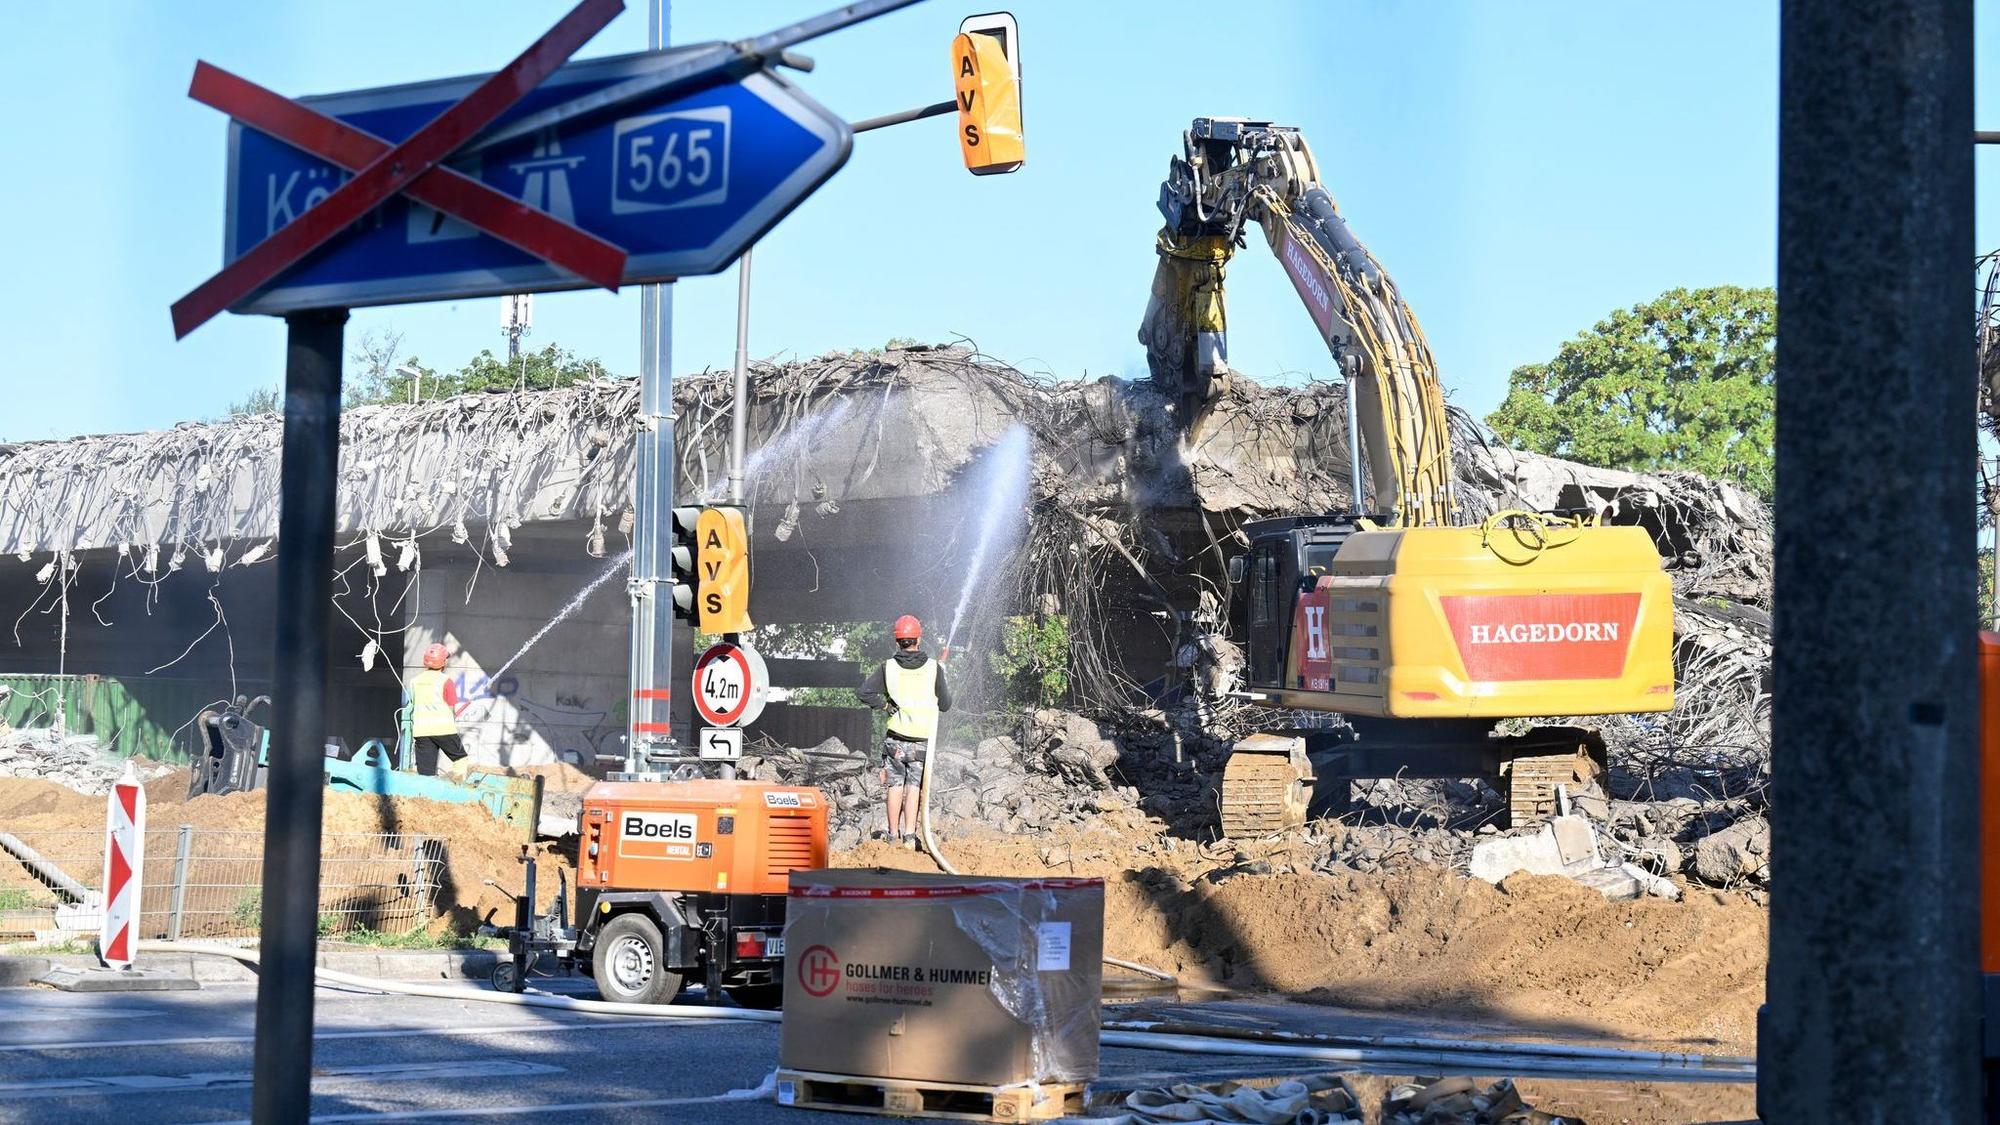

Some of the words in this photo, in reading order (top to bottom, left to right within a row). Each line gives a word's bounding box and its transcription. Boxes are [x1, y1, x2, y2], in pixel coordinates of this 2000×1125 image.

[960, 56, 980, 147] AVS
[629, 128, 713, 192] 565
[1287, 240, 1329, 313] HAGEDORN
[704, 529, 723, 614] AVS
[1305, 606, 1326, 659] H
[1470, 622, 1619, 645] HAGEDORN
[766, 794, 799, 806] Boels
[625, 817, 693, 839] Boels
[845, 980, 877, 993] hoses
[879, 982, 894, 995] for
[896, 983, 934, 997] heroes
[846, 963, 910, 981] GOLLMER
[914, 967, 925, 982] &
